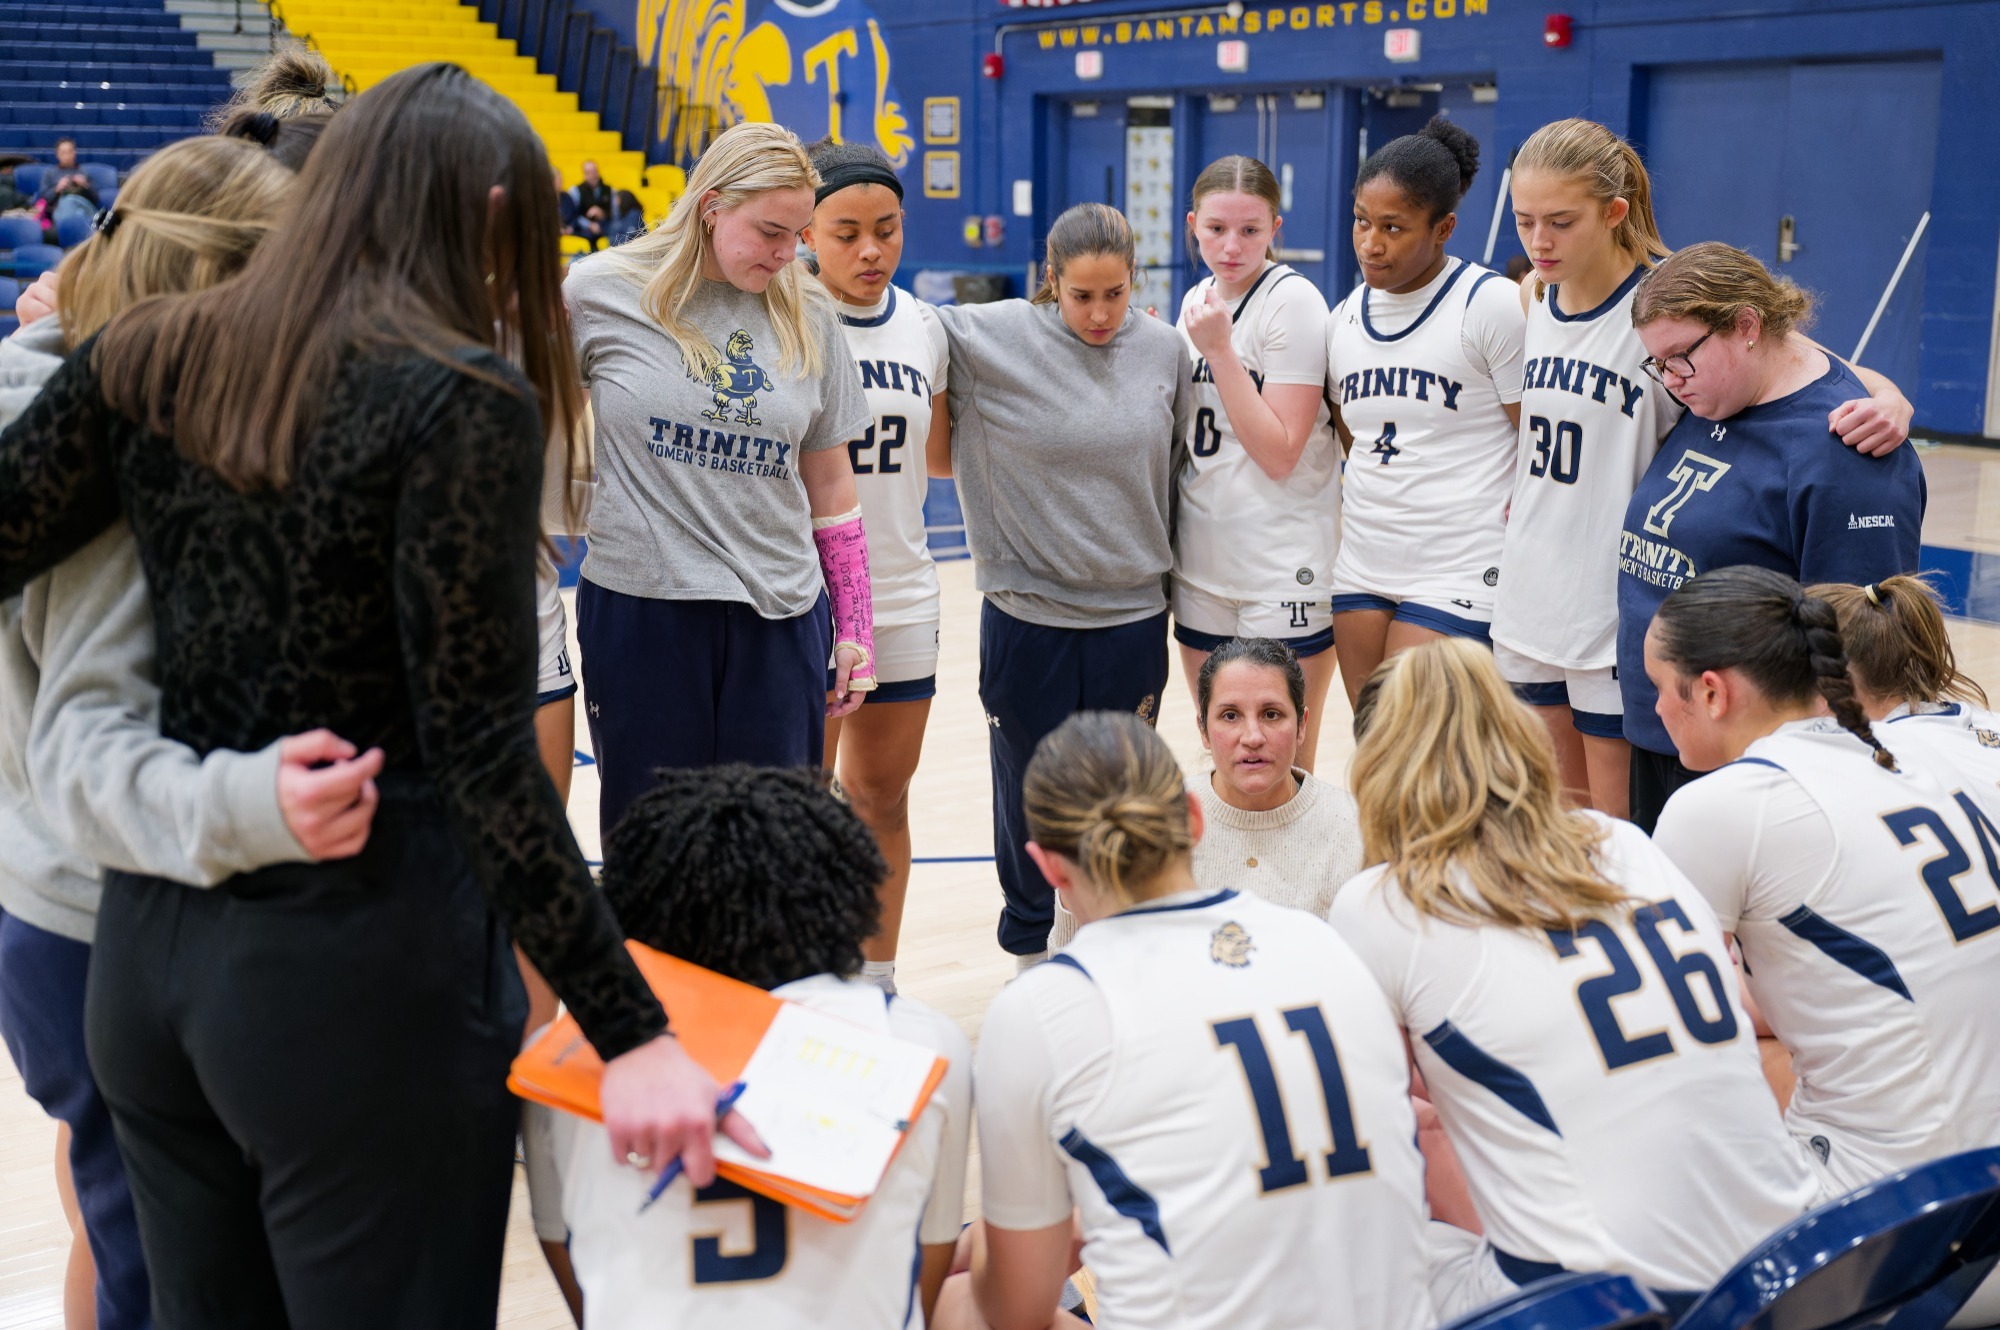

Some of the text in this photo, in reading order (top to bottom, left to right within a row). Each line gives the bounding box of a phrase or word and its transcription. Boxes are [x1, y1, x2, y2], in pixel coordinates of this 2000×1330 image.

[855, 359, 932, 409] NITY
[1339, 367, 1463, 411] RINITY
[1523, 356, 1644, 420] RINITY
[649, 417, 791, 466] TRINITY
[847, 414, 907, 474] 22
[1193, 407, 1222, 457] 0
[1369, 421, 1401, 465] 4
[1529, 415, 1583, 485] 30
[711, 456, 789, 480] BASKETBALL
[1643, 449, 1732, 539] T
[1619, 556, 1691, 591] MEN'S BASKETB
[1546, 898, 1740, 1075] 26
[1207, 1002, 1374, 1198] 11
